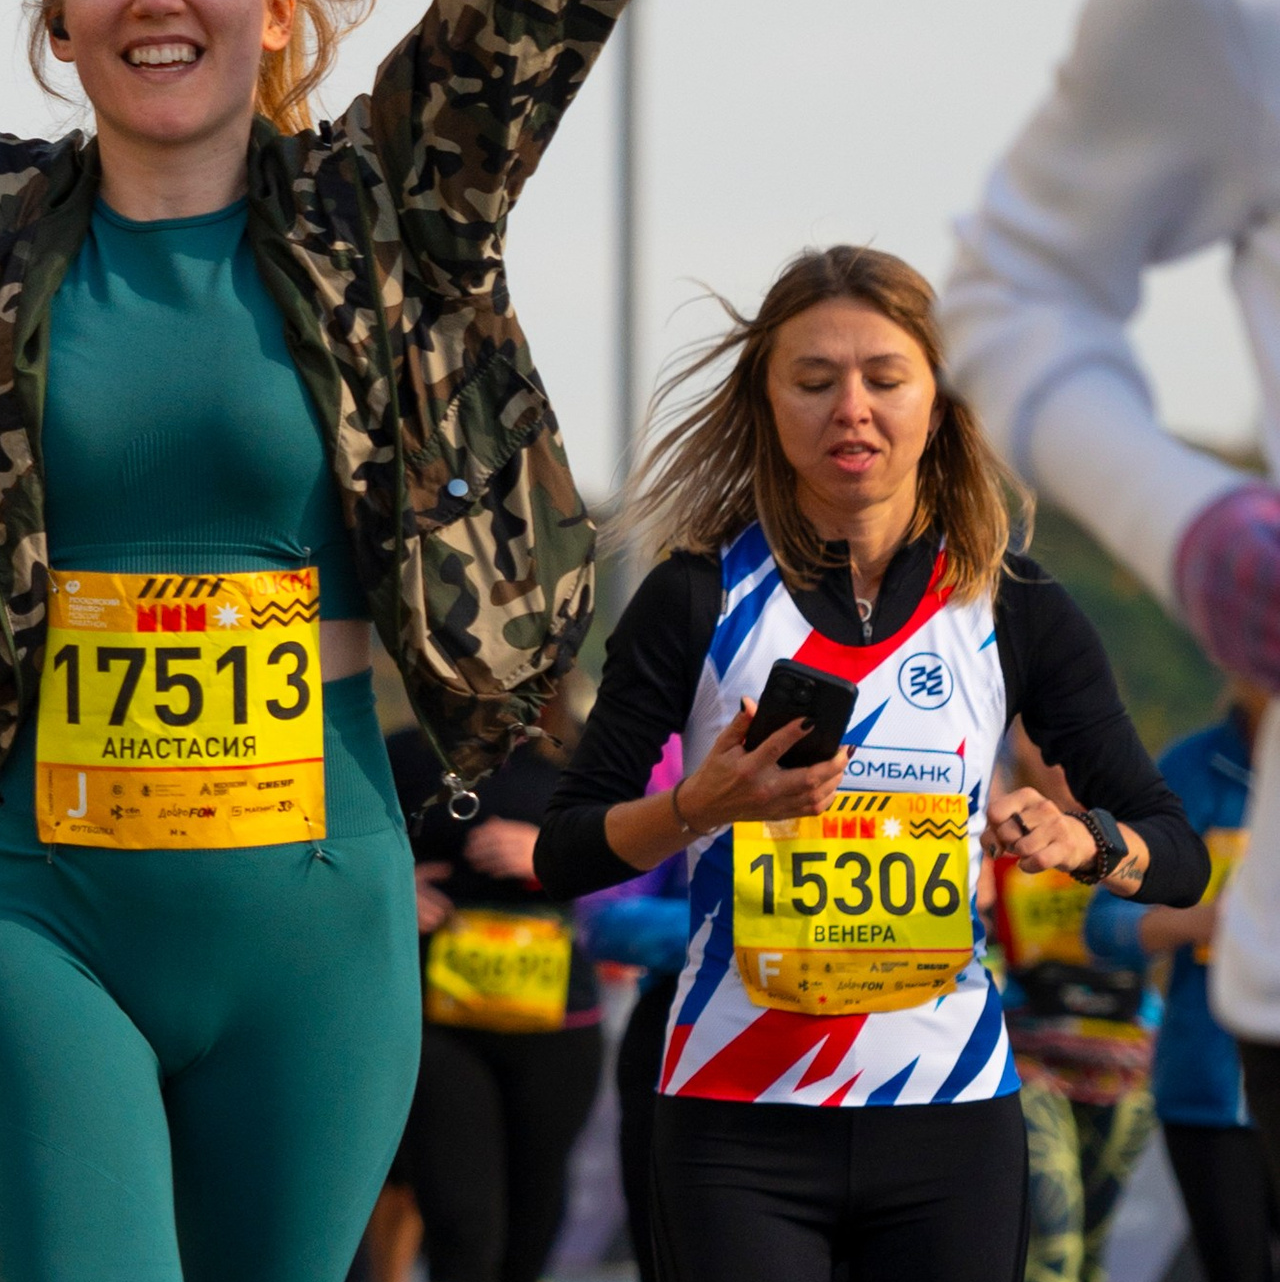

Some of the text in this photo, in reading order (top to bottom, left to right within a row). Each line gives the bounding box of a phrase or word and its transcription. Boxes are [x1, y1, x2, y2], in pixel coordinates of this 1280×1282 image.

[54, 641, 311, 727] 17513
[101, 736, 257, 759] АНАСТАСИЯ
[67, 771, 87, 818] J
[750, 852, 961, 916] 15306
[814, 925, 897, 943] ВЕНЕРА
[757, 952, 783, 988] F
